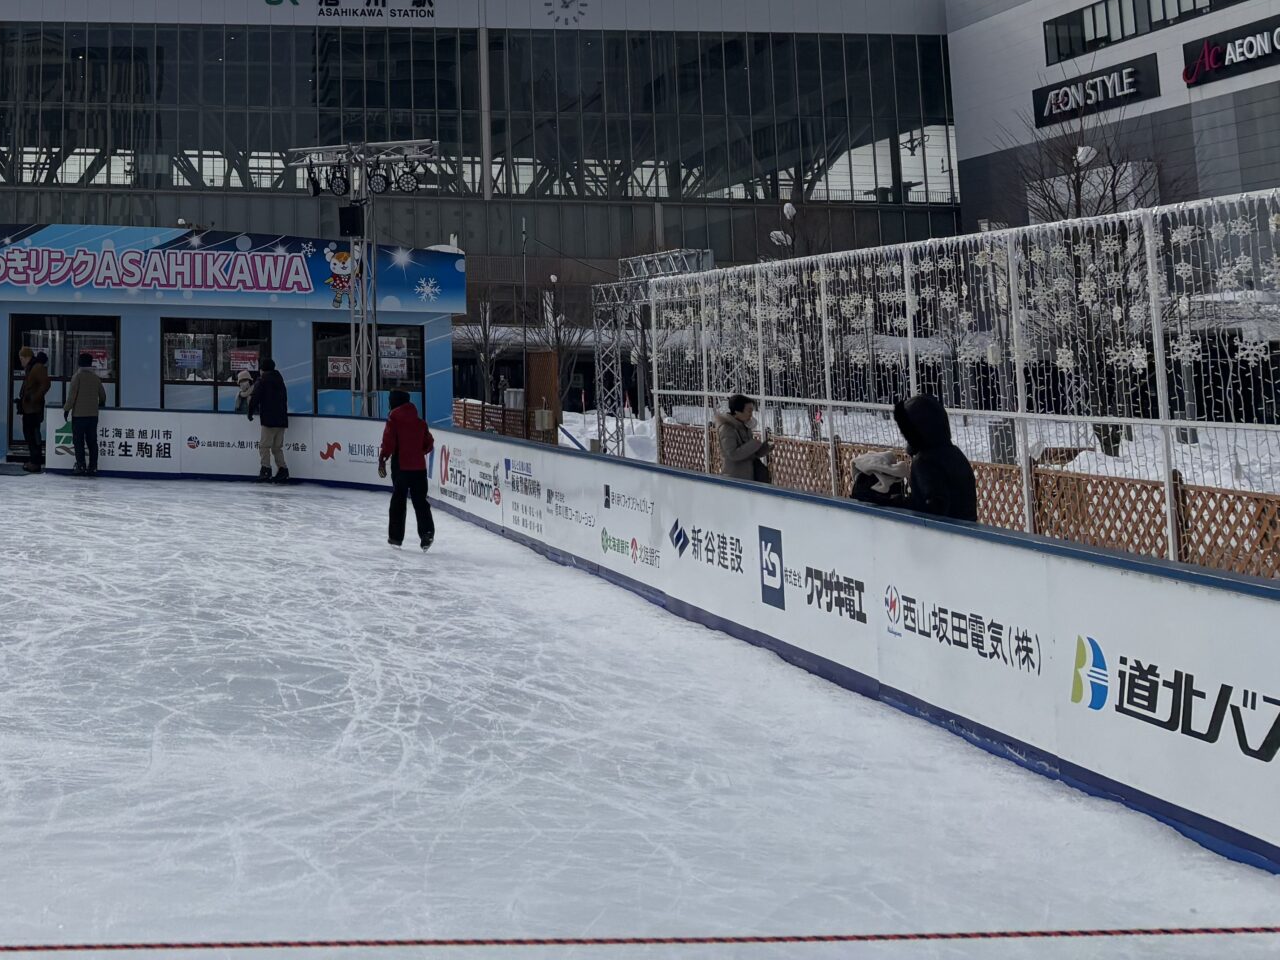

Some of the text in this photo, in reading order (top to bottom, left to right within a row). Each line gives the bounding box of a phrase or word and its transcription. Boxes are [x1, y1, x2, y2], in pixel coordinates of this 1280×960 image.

[318, 8, 434, 19] ASAHIKAWA STATION
[1224, 31, 1272, 66] AEON
[1086, 67, 1137, 105] STYLE
[99, 427, 172, 440] 北海道旭川市
[118, 441, 172, 459] 生駒組
[691, 525, 744, 575] 新谷建設
[805, 566, 867, 625] クマザキ電工
[901, 595, 1041, 678] 西山坂田電気(株)
